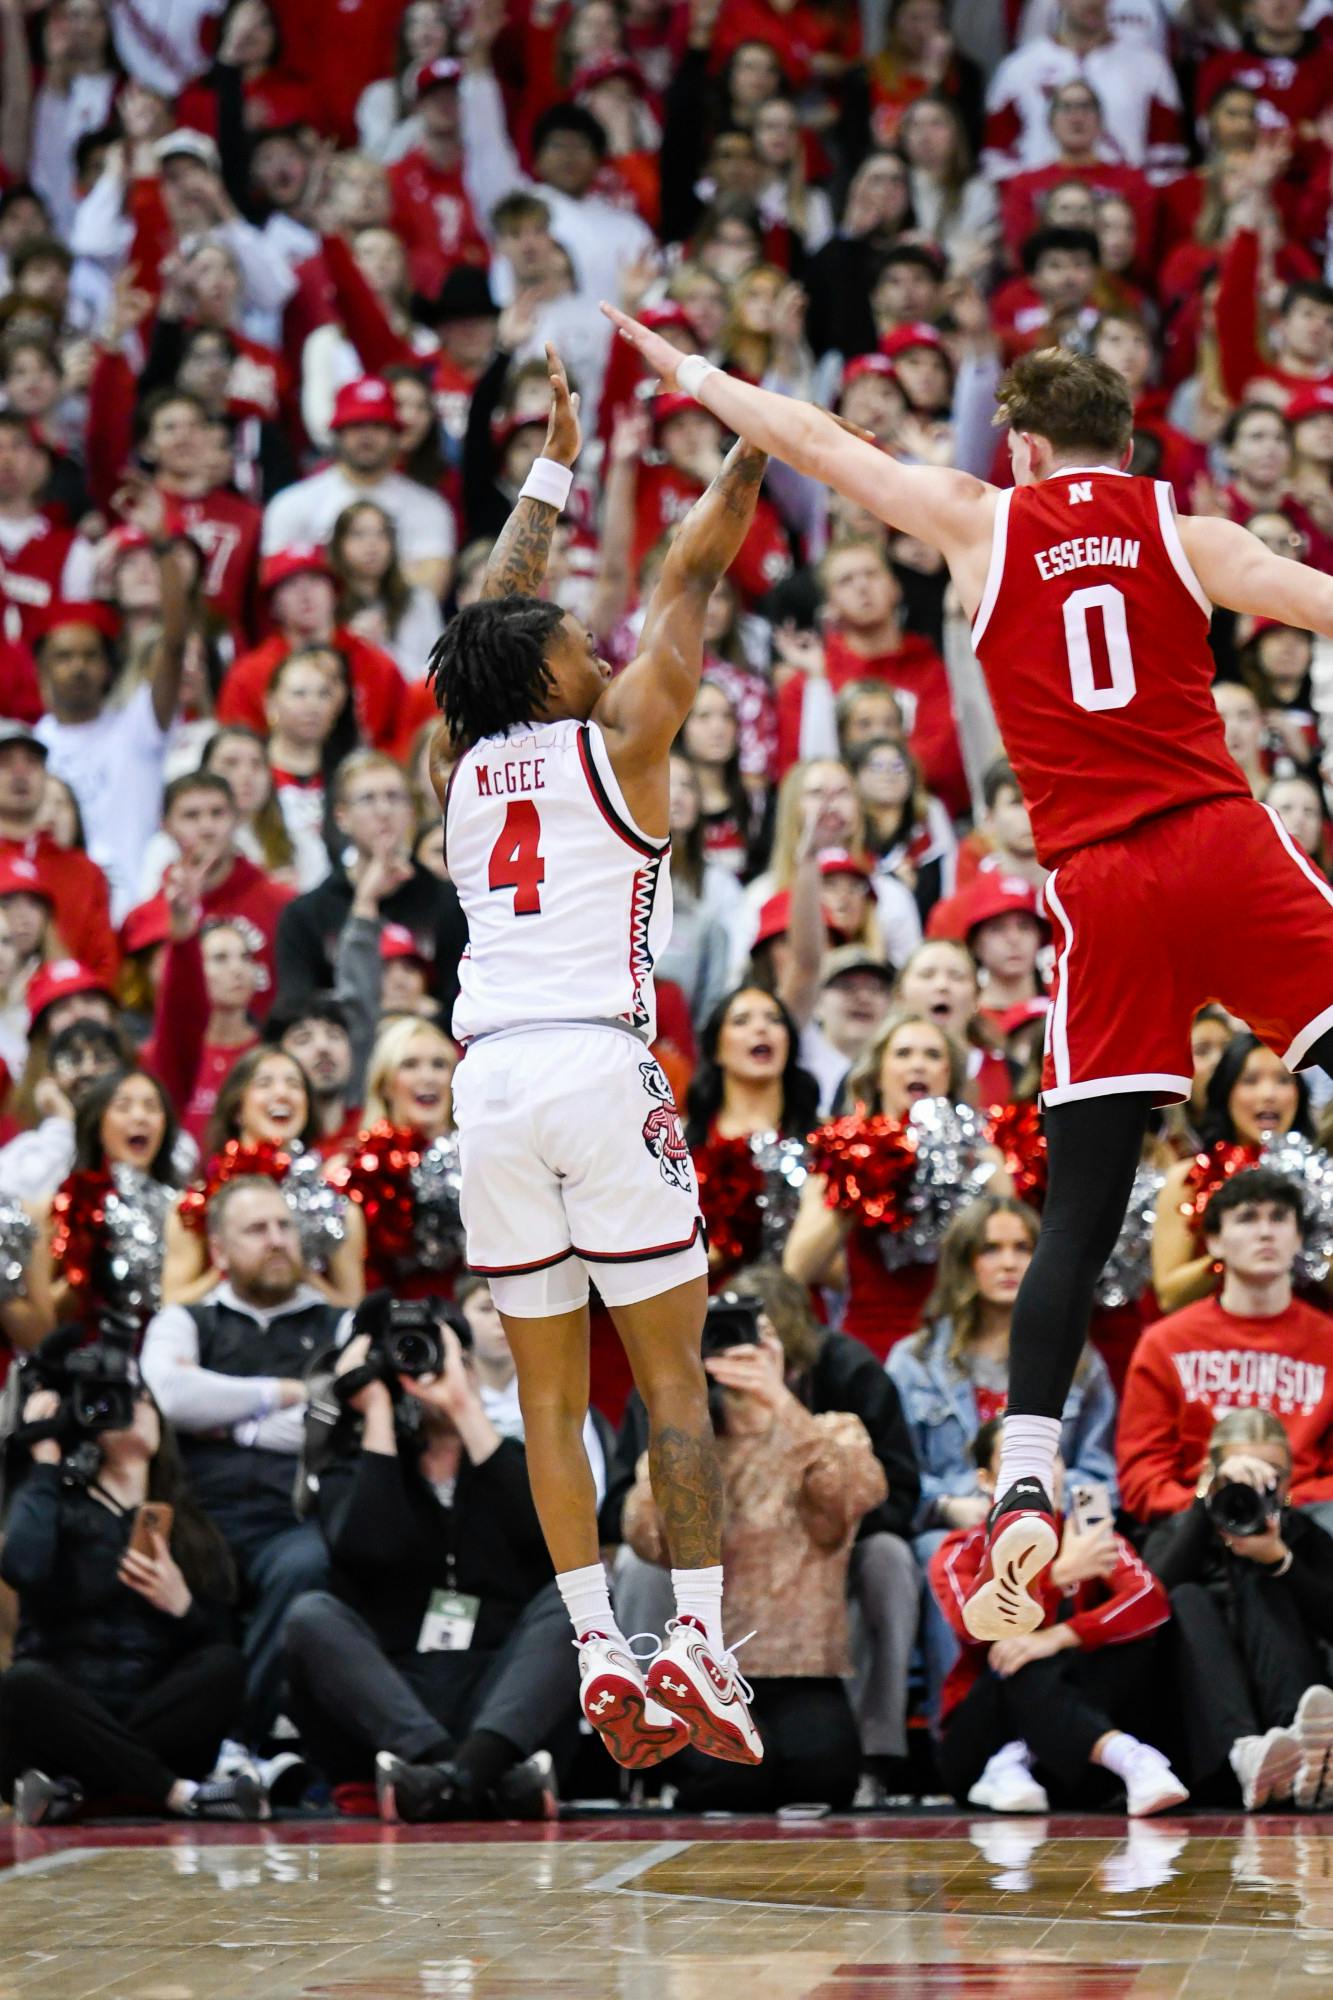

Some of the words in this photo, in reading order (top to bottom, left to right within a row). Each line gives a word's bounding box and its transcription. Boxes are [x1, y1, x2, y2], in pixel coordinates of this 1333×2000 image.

[1068, 481, 1093, 505] N
[1034, 536, 1140, 581] ESSEGIAN
[1062, 584, 1137, 712] 0
[475, 758, 545, 796] McGEE
[488, 799, 545, 916] 4
